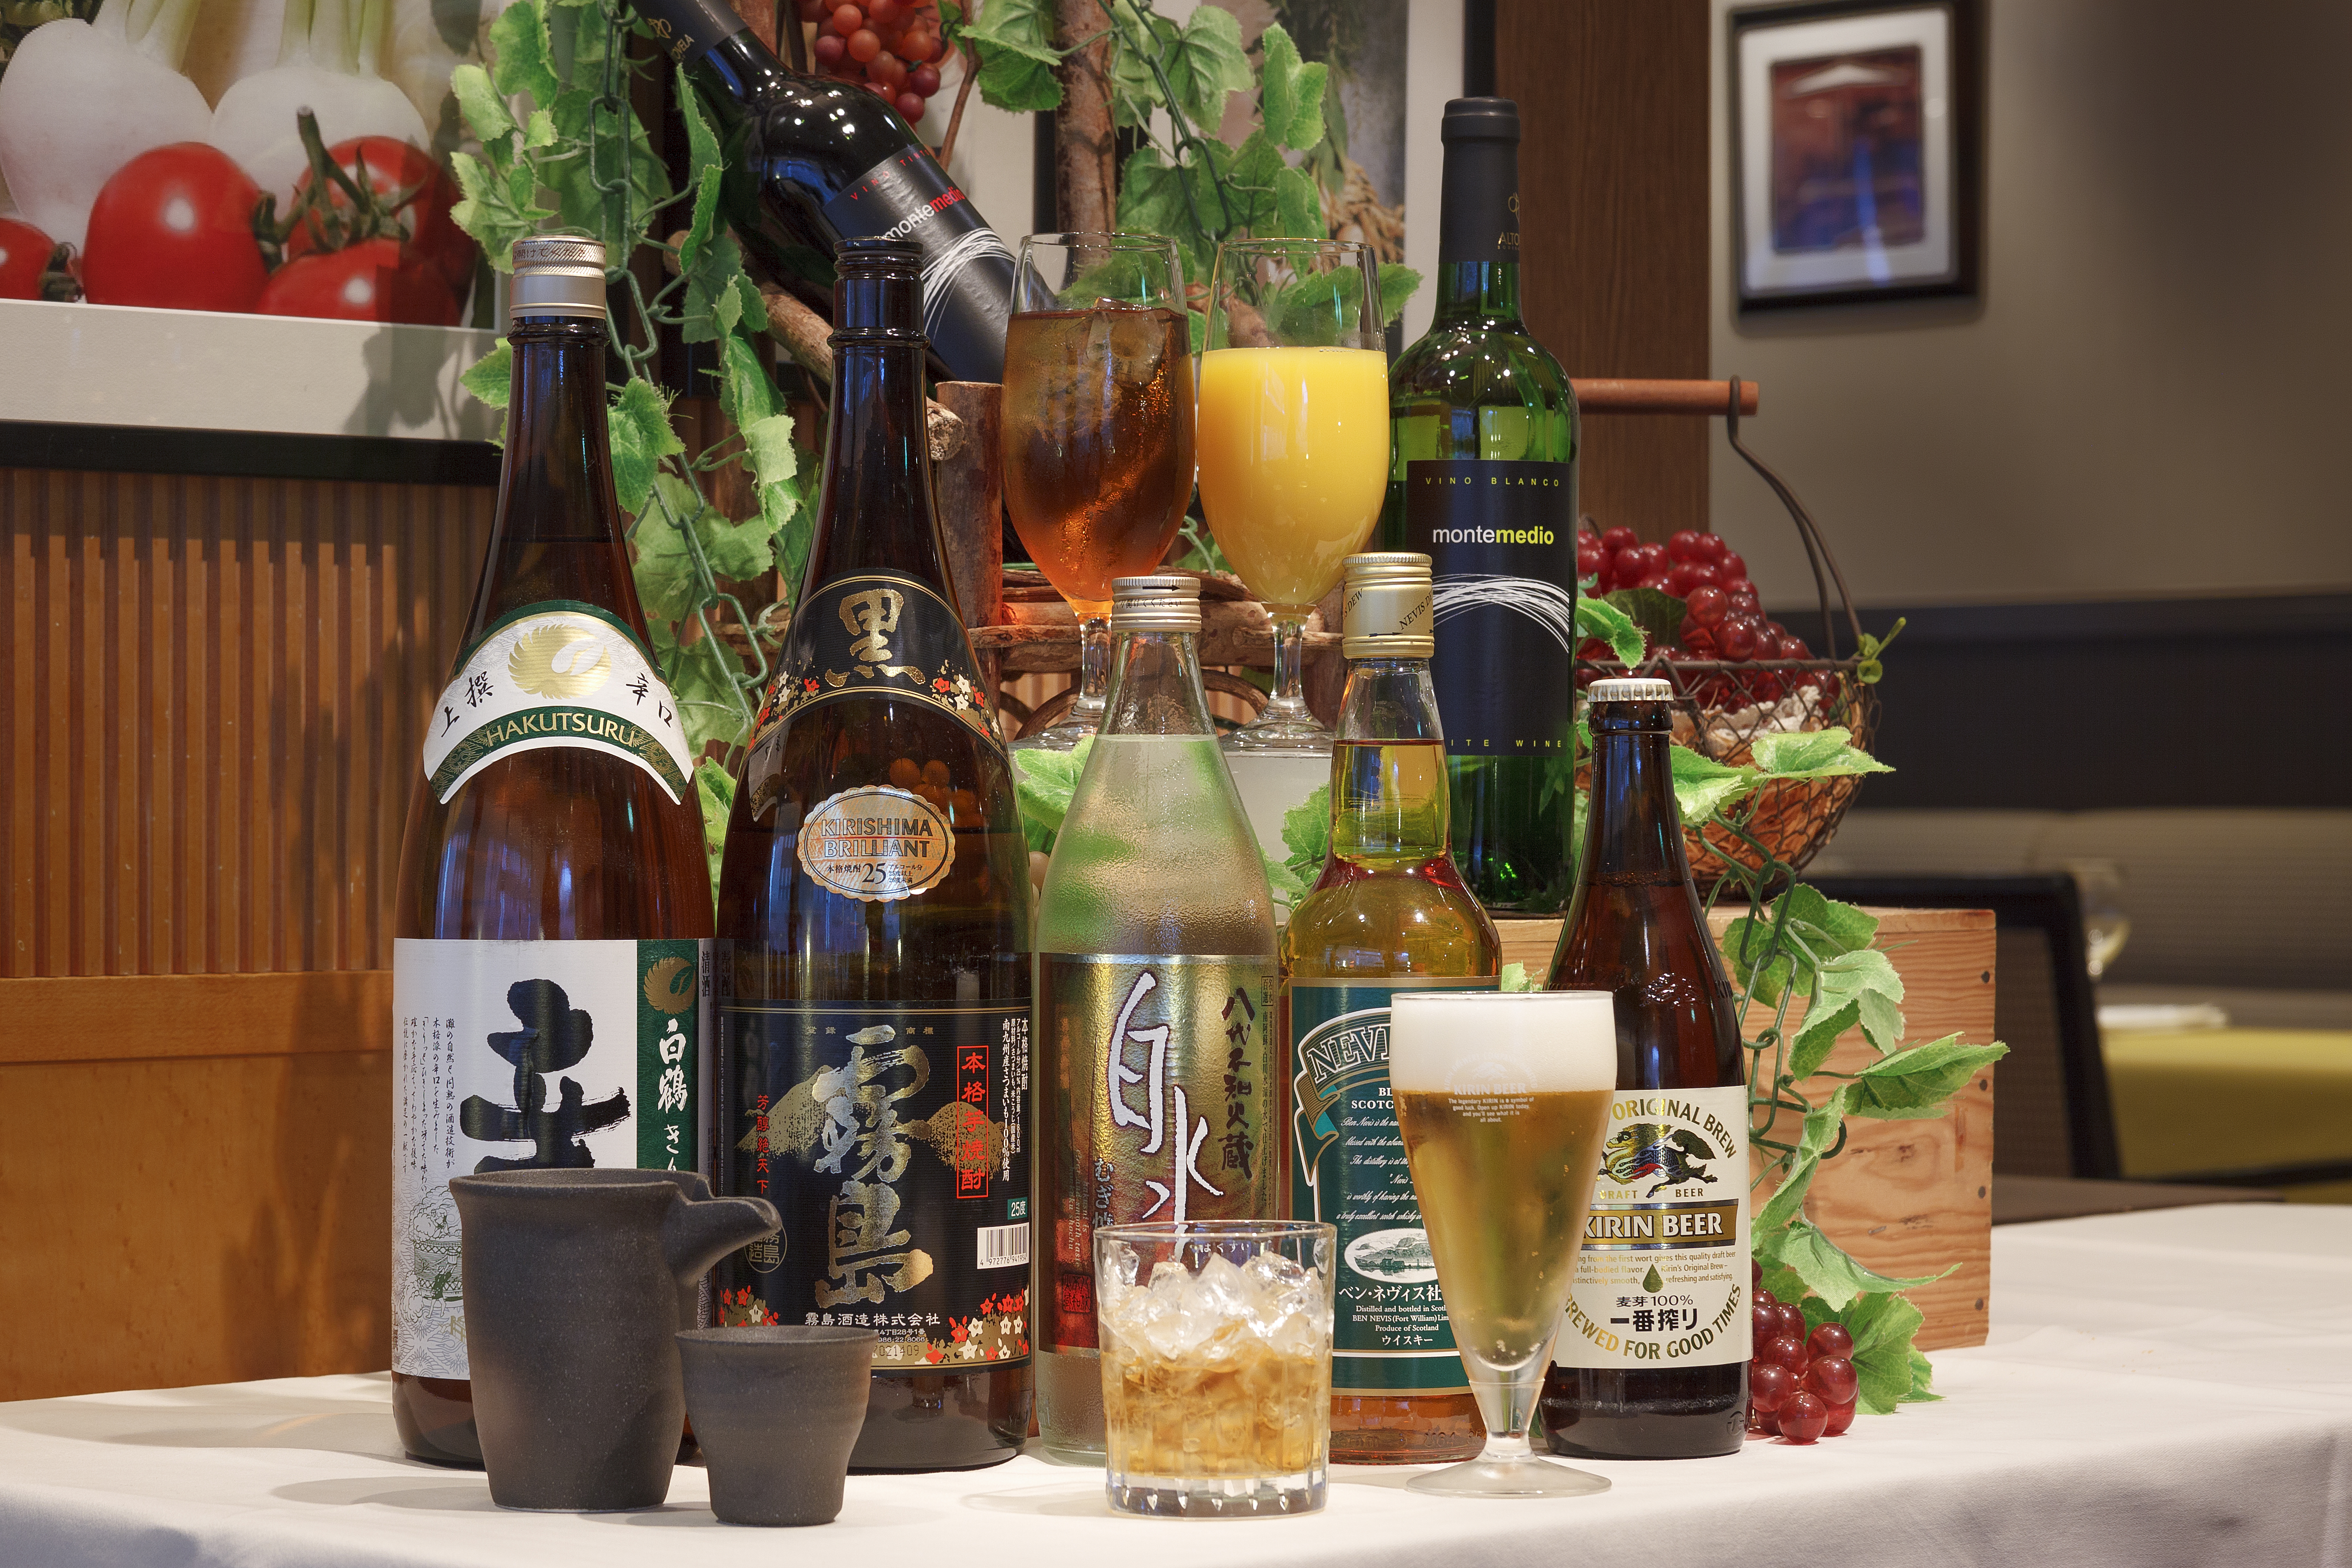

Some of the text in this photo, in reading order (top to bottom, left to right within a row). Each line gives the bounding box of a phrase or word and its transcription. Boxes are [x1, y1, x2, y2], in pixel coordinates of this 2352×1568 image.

[850, 171, 889, 200] VINO
[883, 187, 965, 238] montemedio
[1491, 477, 1559, 487] BLANCO
[1433, 525, 1554, 545] montemedio
[1348, 588, 1363, 612] DEW
[1399, 601, 1425, 631] NEVIS
[825, 588, 926, 687] 黒
[487, 712, 635, 747] HAKUTSURU
[1516, 739, 1562, 748] WINE
[821, 818, 933, 836] KIRISHIMA
[825, 839, 930, 858] BRILLIANT
[827, 862, 886, 884] 本格焼酎 25
[1307, 1024, 1391, 1083] NEVI
[658, 1018, 687, 1114] 白鶴
[1454, 1083, 1526, 1095] KIRIN BEER
[1351, 1100, 1394, 1109] SCOTC
[962, 1052, 986, 1190] 本格芋焼酎
[1108, 972, 1224, 1261] 白水
[1341, 1117, 1357, 1127] Ben
[1357, 1116, 1374, 1127] Nevis
[1379, 1117, 1389, 1127] the
[1612, 1097, 1701, 1126] ORIGINAL
[1703, 1113, 1737, 1159] BREW
[757, 1094, 769, 1194] 芳醇絶天下
[812, 1024, 933, 1309] 霧島
[1350, 1155, 1363, 1165] The
[1363, 1155, 1387, 1168] distillery
[1092, 1158, 1114, 1228] むぎ焼
[1353, 1190, 1373, 1203] worthy
[1372, 1190, 1384, 1203] of
[1378, 1190, 1400, 1204] having
[1400, 1190, 1410, 1200] the
[1600, 1188, 1704, 1199] DRAFT BEER
[1011, 1200, 1026, 1217] 25度
[1340, 1210, 1357, 1223] truly
[1354, 1210, 1381, 1220] excellent
[1379, 1210, 1399, 1220] scotch
[1396, 1210, 1417, 1223] whisky
[1662, 1212, 1724, 1238] BEER
[989, 1256, 1010, 1266] 972776
[1654, 1254, 1673, 1263] gives
[1689, 1252, 1711, 1262] quality
[1684, 1263, 1709, 1273] Original
[1573, 1276, 1608, 1286] istinctively
[1666, 1274, 1697, 1283] refreshing
[1616, 1294, 1693, 1308] 麦芽100%
[805, 1312, 940, 1327] 霧島酒造株式会社
[1392, 1315, 1409, 1323] (Fort
[1410, 1314, 1437, 1323] William)
[1610, 1308, 1698, 1332] 一番搾り
[1623, 1339, 1661, 1360] FOR
[1666, 1327, 1715, 1359] GOOD
[1712, 1283, 1742, 1334] TIMES
[1382, 1334, 1433, 1346] ウイスキー
